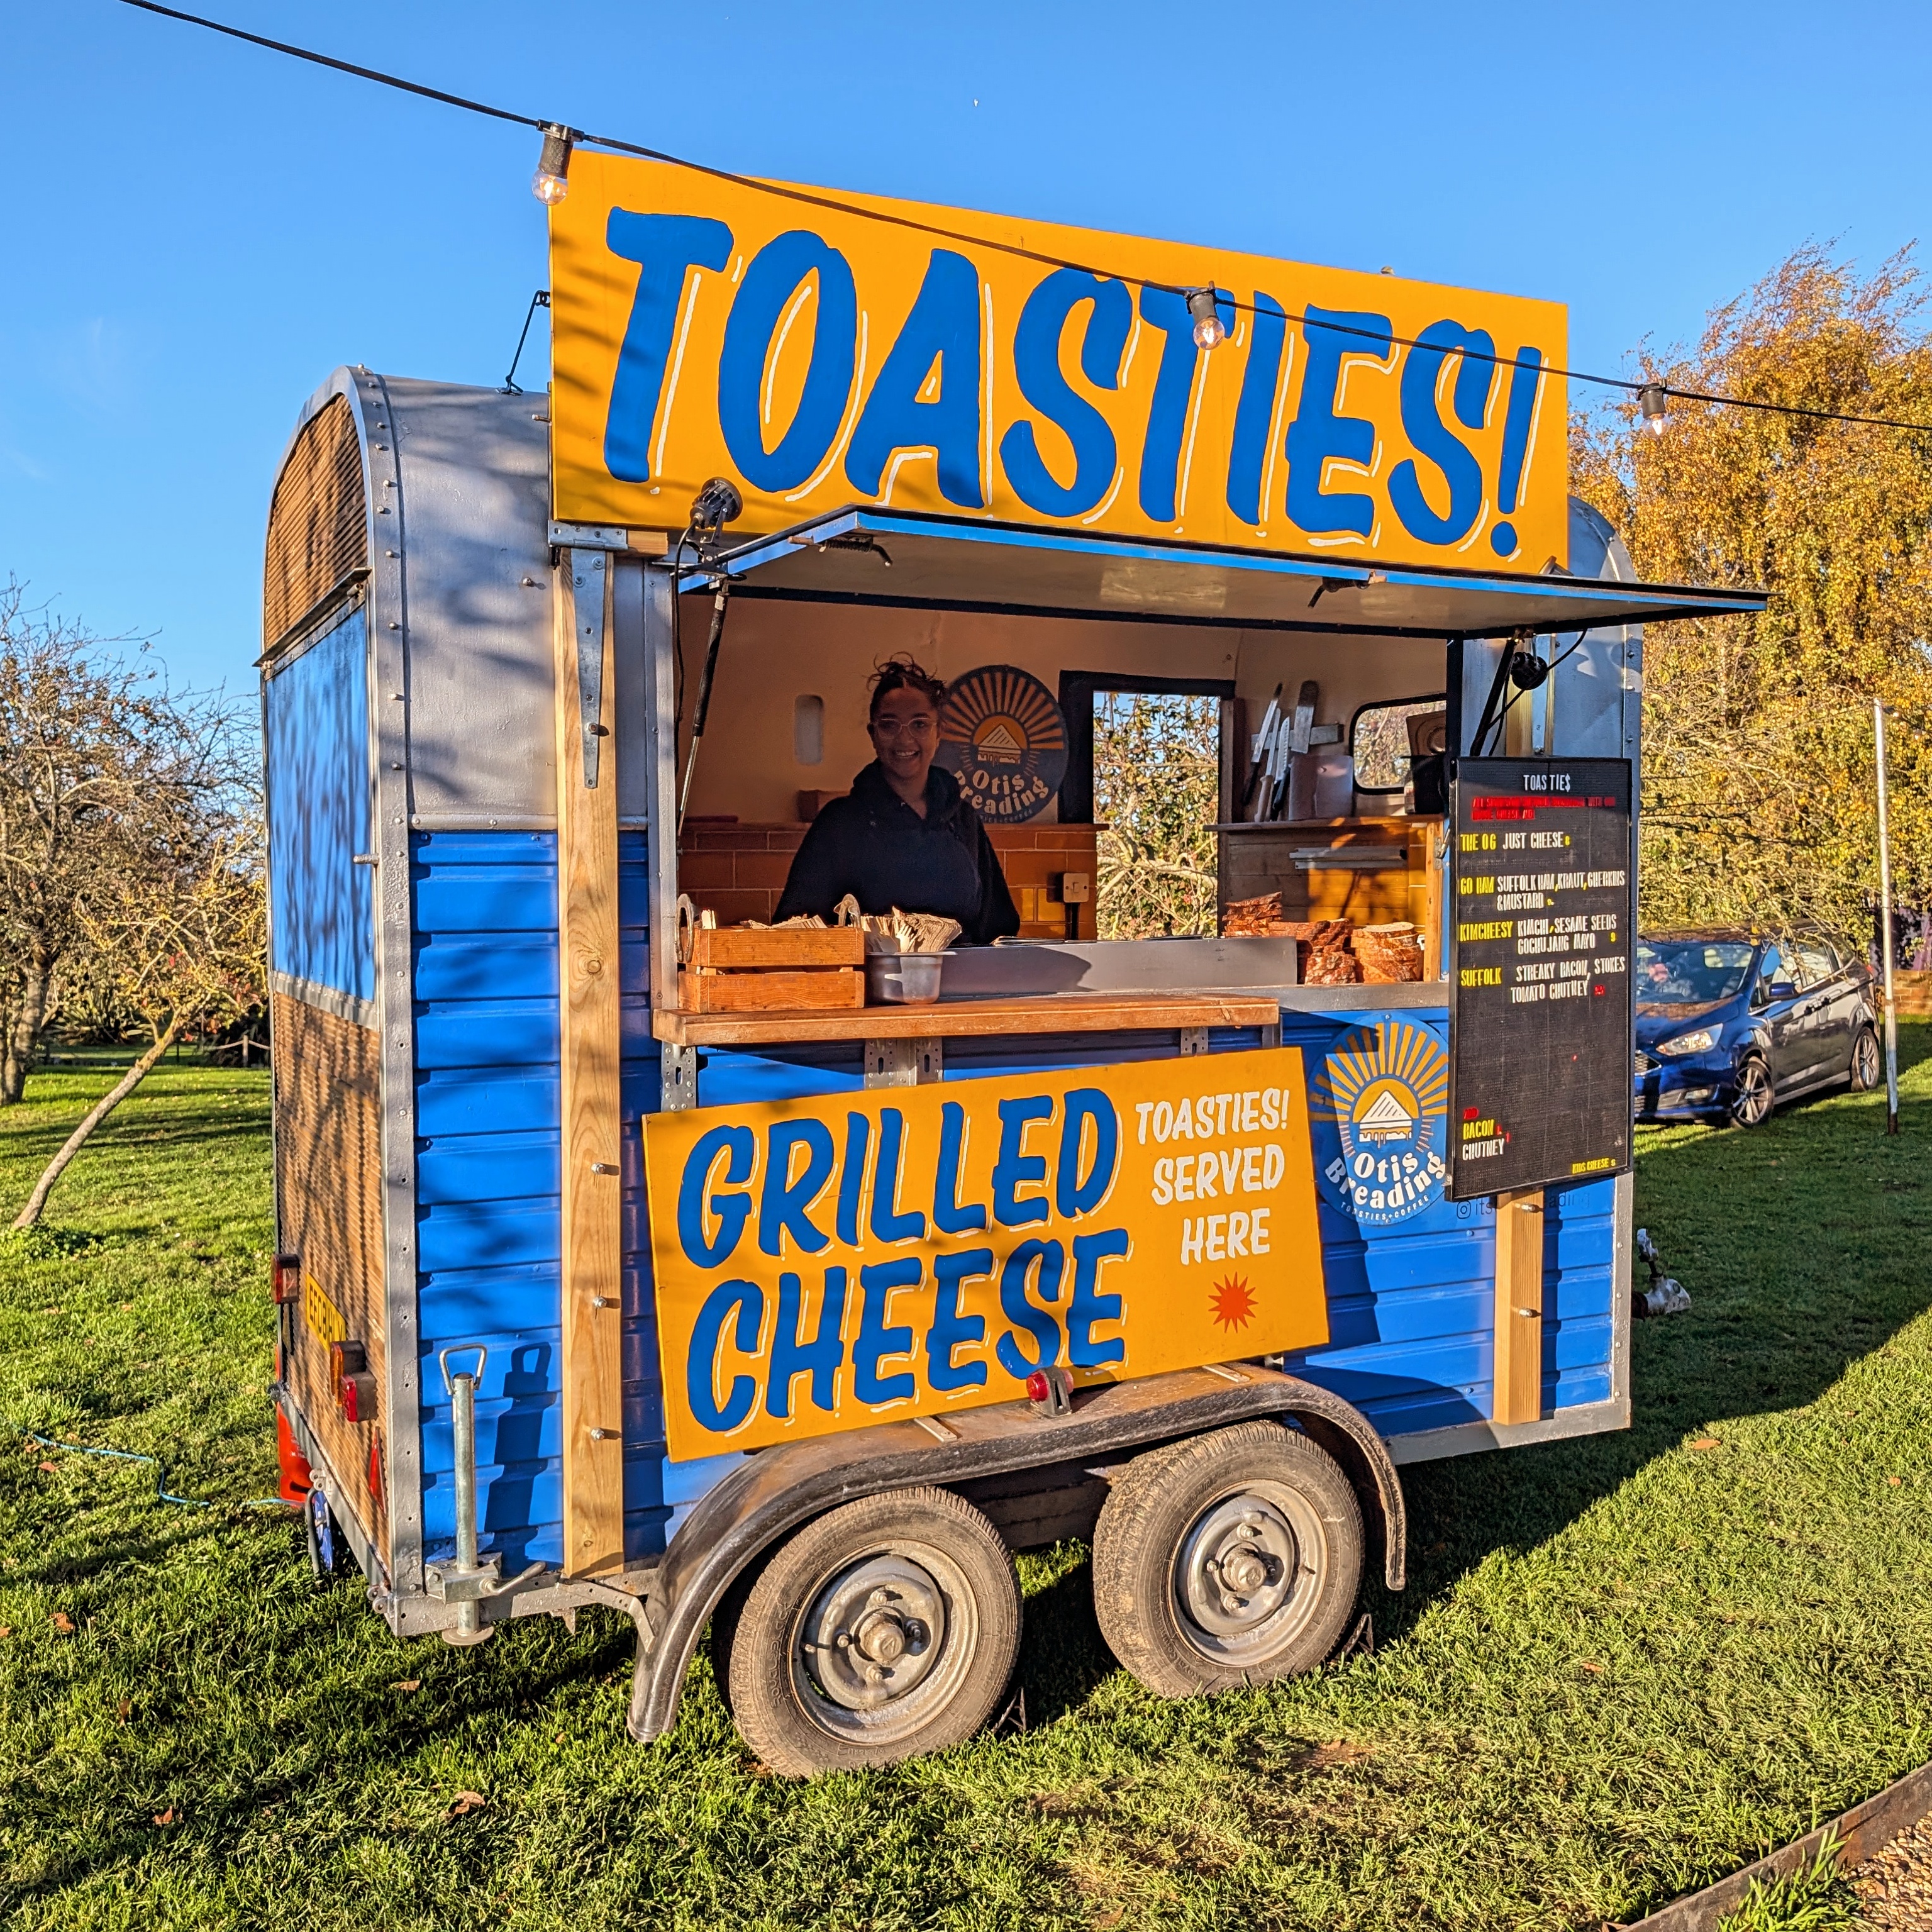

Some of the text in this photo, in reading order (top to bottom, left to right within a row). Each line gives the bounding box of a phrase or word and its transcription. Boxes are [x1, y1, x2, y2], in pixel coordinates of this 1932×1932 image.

[604, 206, 1547, 558] TOASTIES!
[973, 770, 1024, 795] Otis
[1460, 833, 1479, 851] THE
[1482, 833, 1496, 850] OG
[1502, 832, 1527, 850] JUST
[1530, 831, 1563, 848] CHEESE
[1460, 877, 1473, 894] GO
[1476, 876, 1495, 894] HAM
[1497, 874, 1536, 892] SUFFOLK
[1460, 921, 1513, 942] KIMCHEESY
[1554, 915, 1588, 933] SESAME
[1591, 914, 1617, 931] SEEDS
[1518, 935, 1569, 955] GOCHUJANG
[1574, 933, 1596, 949] MAYO
[1461, 956, 1625, 987] SUFFOLK STREAKY BACON, STOKES
[1511, 983, 1545, 1003] TOMATO
[1549, 980, 1588, 999] CHUTNEY
[1135, 1087, 1289, 1145] TOASTIES!
[1463, 1119, 1494, 1140] BACON
[1462, 1138, 1504, 1161] CHUTNEY
[677, 1087, 1121, 1269] GRILLED
[1152, 1144, 1285, 1206] SERVED
[1325, 1152, 1446, 1209] Breading
[1354, 1152, 1418, 1183] Otis
[1572, 1162, 1585, 1174] KIDS
[1587, 1158, 1609, 1170] CHEESE
[1180, 1208, 1271, 1265] HERE
[687, 1227, 1132, 1435] CHEESE
